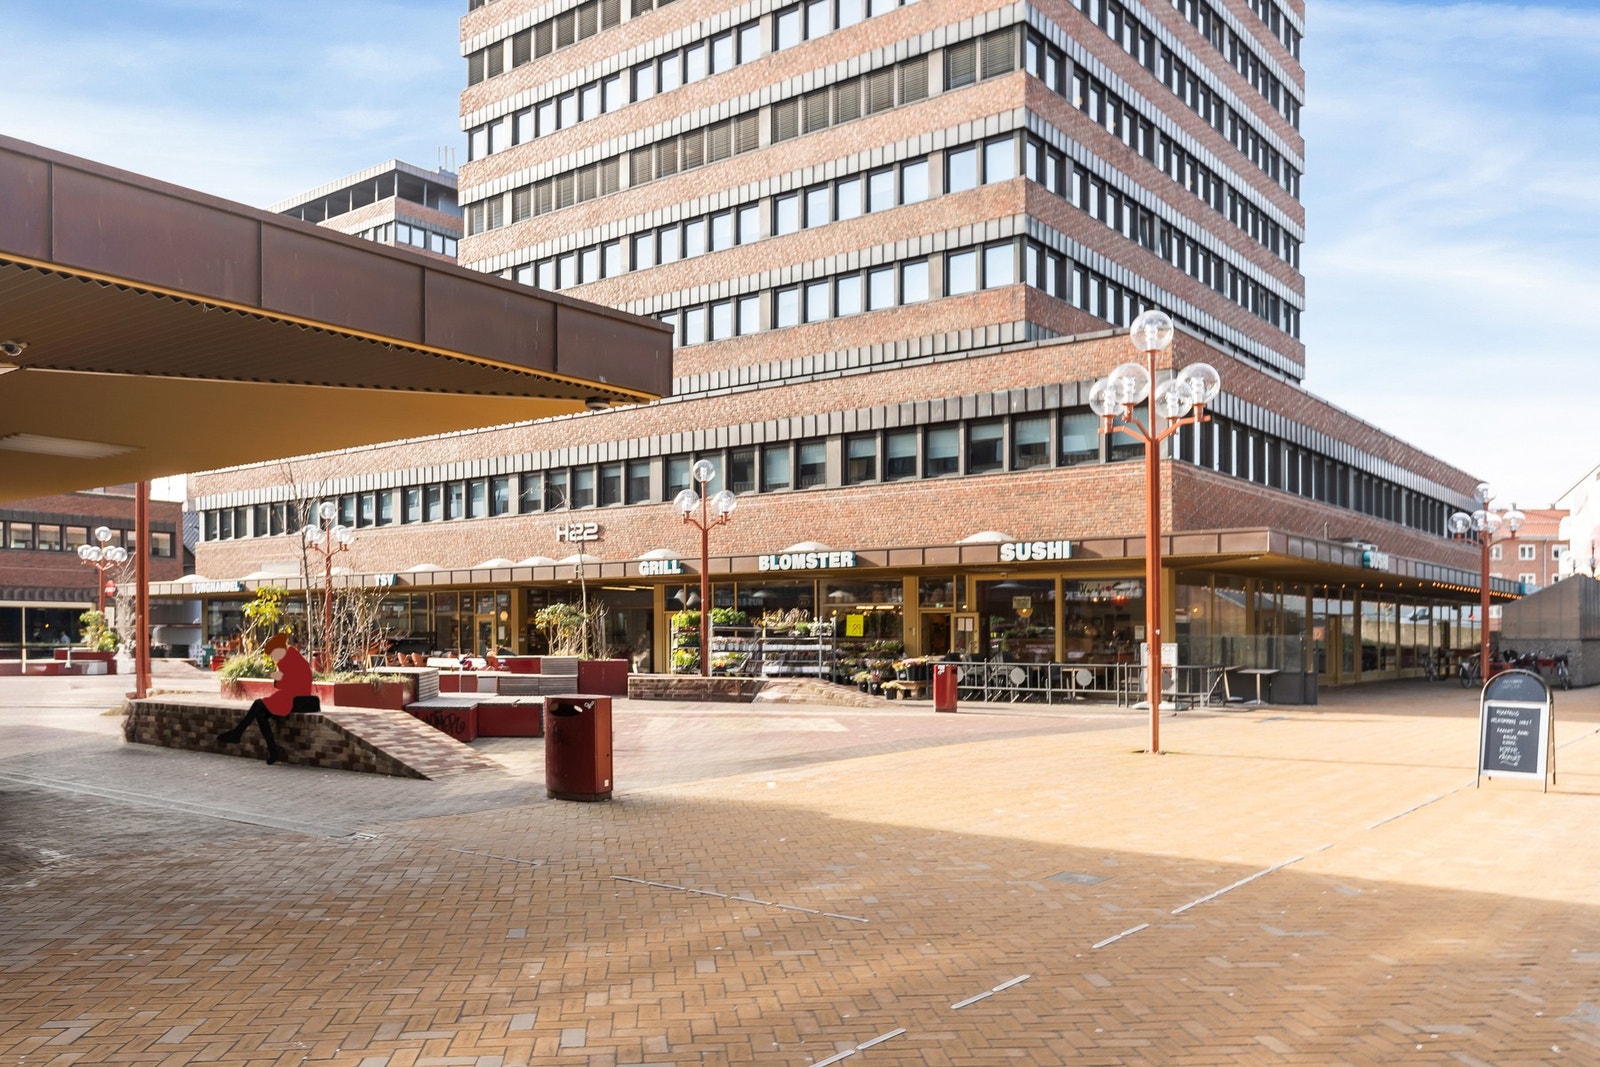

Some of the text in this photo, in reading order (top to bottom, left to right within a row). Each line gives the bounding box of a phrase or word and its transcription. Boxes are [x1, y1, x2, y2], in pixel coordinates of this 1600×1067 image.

[556, 522, 598, 541] H22
[1000, 540, 1070, 561] SUSHI
[639, 560, 682, 576] GRILL
[758, 551, 855, 571] BLOMSTER
